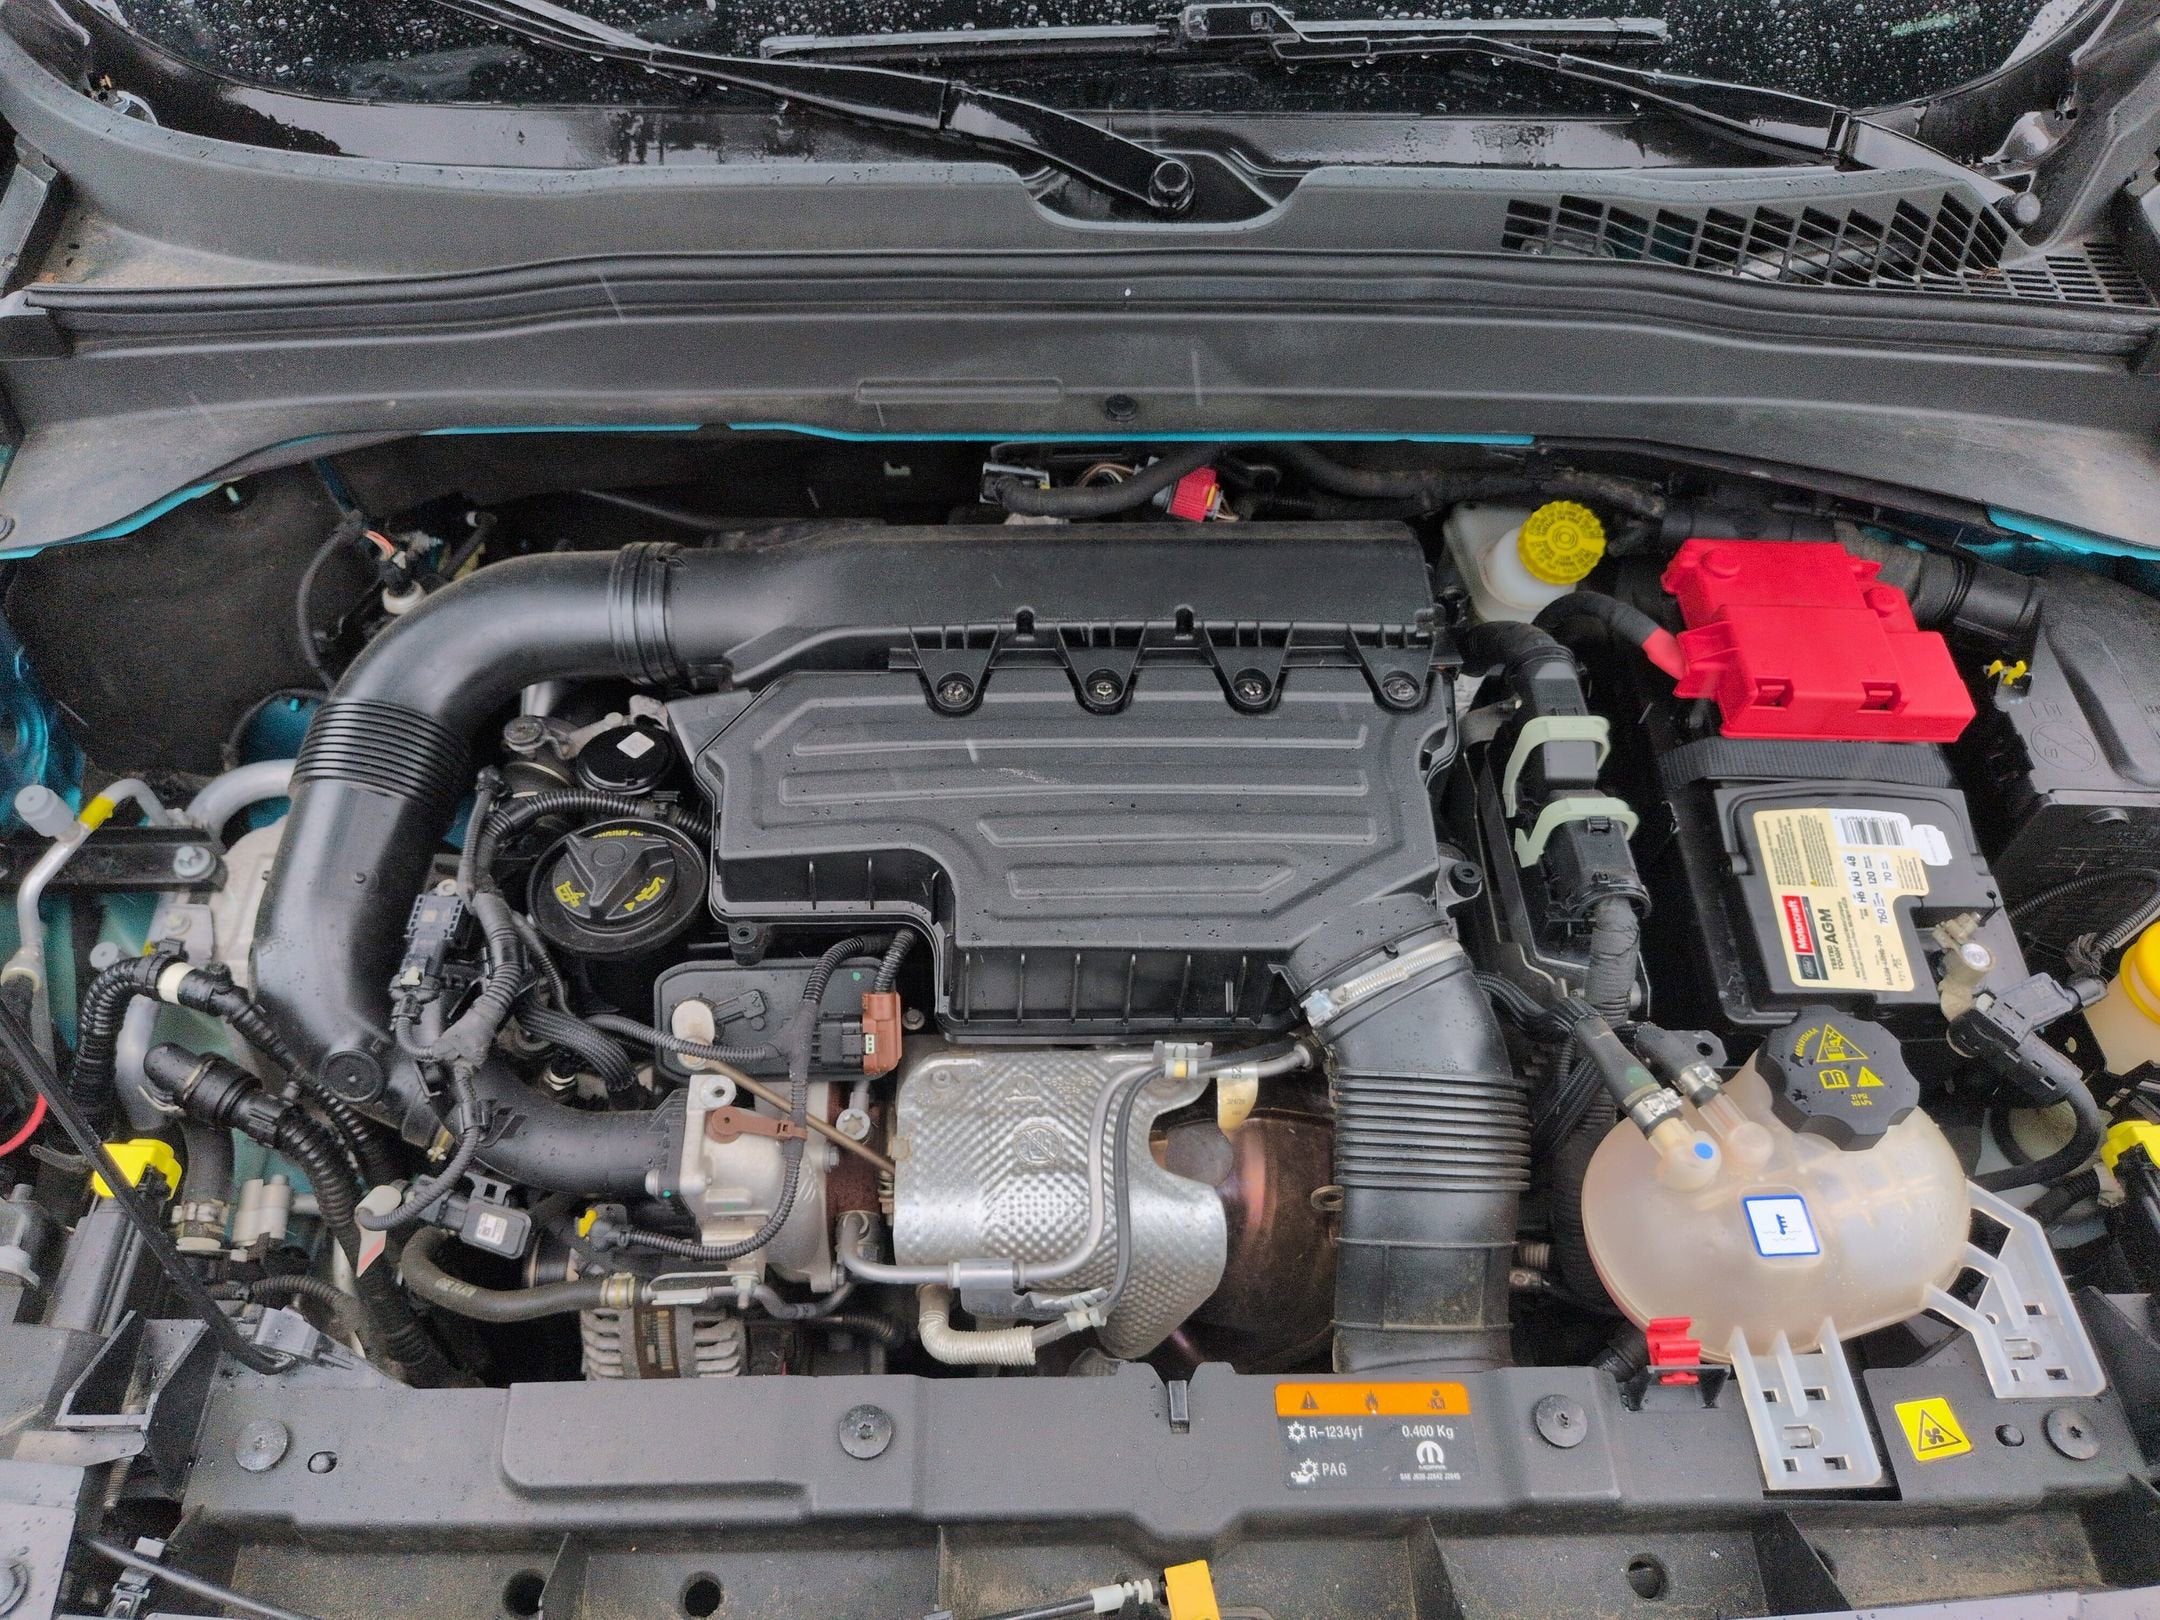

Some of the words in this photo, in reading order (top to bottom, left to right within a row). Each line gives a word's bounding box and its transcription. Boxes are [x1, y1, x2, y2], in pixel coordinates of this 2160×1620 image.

[1847, 855, 1857, 866] 48
[1851, 871, 1862, 887] LN3
[1867, 871, 1877, 885] 120
[1884, 872, 1893, 882] 70
[1857, 891, 1867, 903] H6
[1877, 908, 1888, 924] 760
[1787, 900, 1807, 950] Motorcraft
[1817, 909, 1837, 944] AGM
[1826, 945, 1837, 970] TESTED
[1309, 1425, 1363, 1440] R-1234yf
[1402, 1425, 1434, 1437] 0.400
[1436, 1425, 1454, 1440] Kg
[1322, 1463, 1347, 1476] PAG
